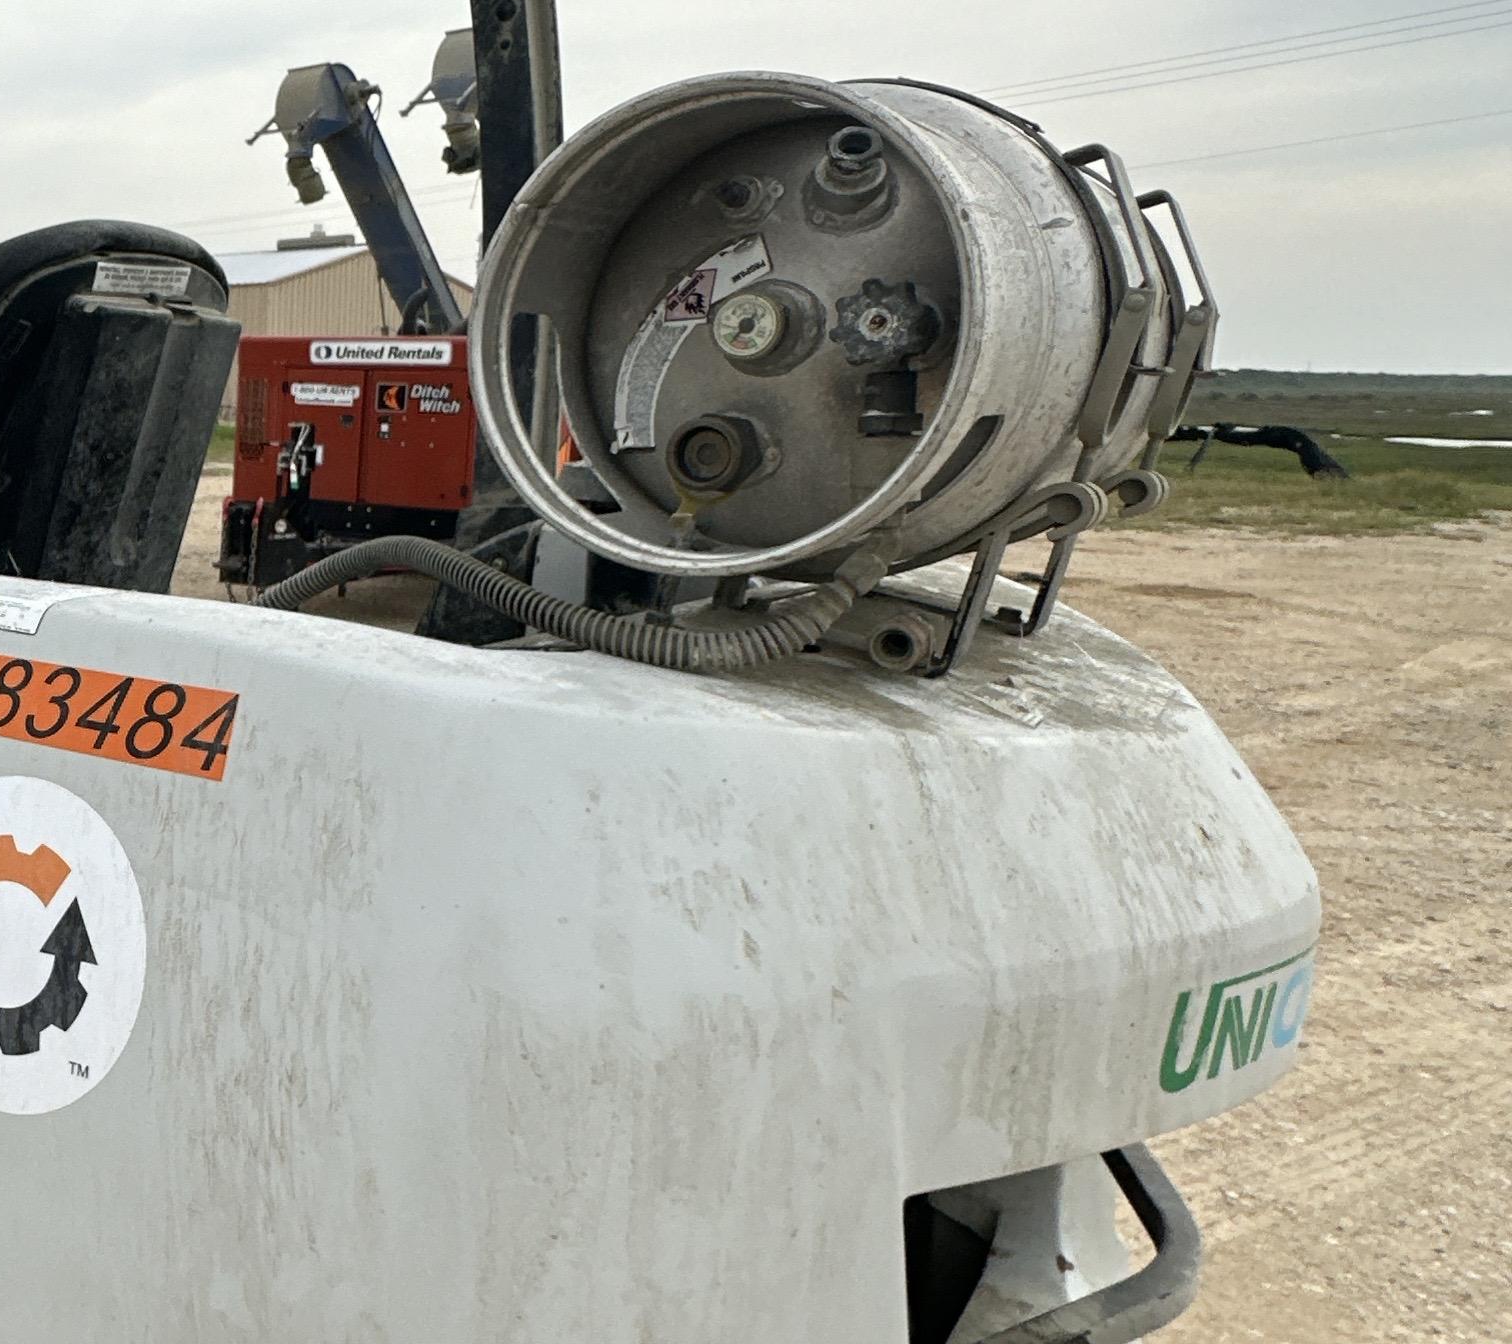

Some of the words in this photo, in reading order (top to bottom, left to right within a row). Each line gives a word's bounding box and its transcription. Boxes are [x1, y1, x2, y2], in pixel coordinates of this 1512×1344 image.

[336, 346, 384, 360] United
[387, 346, 444, 361] Rentals
[410, 384, 450, 399] Ditch
[419, 399, 460, 413] Witch
[68, 1060, 90, 1080] TM
